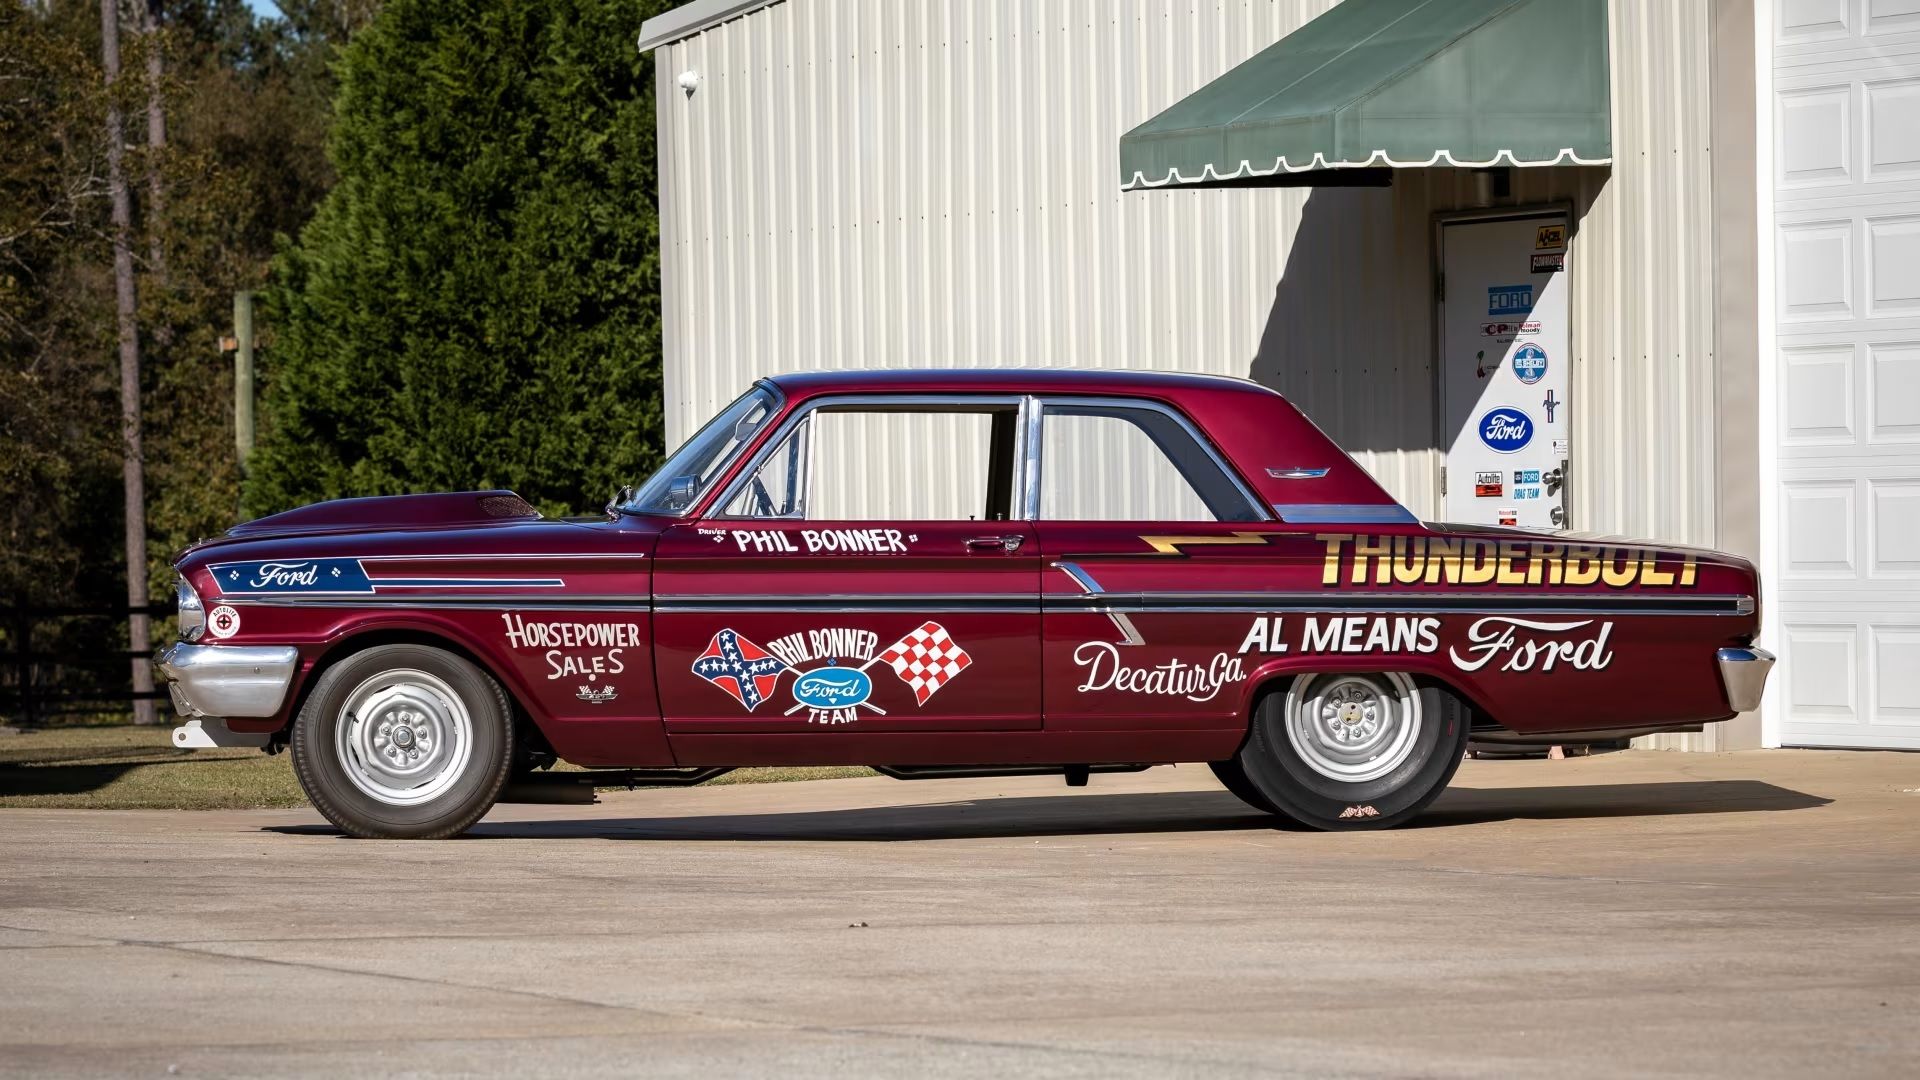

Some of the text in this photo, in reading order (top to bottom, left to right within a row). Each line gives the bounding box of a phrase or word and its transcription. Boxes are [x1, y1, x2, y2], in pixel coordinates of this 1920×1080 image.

[1489, 291, 1532, 309] FORD
[1485, 414, 1526, 440] Ford
[1477, 473, 1501, 485] Autolite
[1523, 473, 1539, 481] FORD
[1527, 487, 1540, 499] TEAM
[697, 527, 907, 552] DRIVER PHIL BONNER
[1315, 533, 1697, 587] THUNDERBOLT
[249, 561, 319, 588] Ford
[501, 613, 640, 649] HORSEPOWER
[766, 628, 879, 667] PHIL BONNER
[1238, 616, 1613, 672] AL MEANS Ford
[545, 648, 624, 680] SALES
[799, 678, 861, 698] Ford
[808, 706, 858, 725] TEAM
